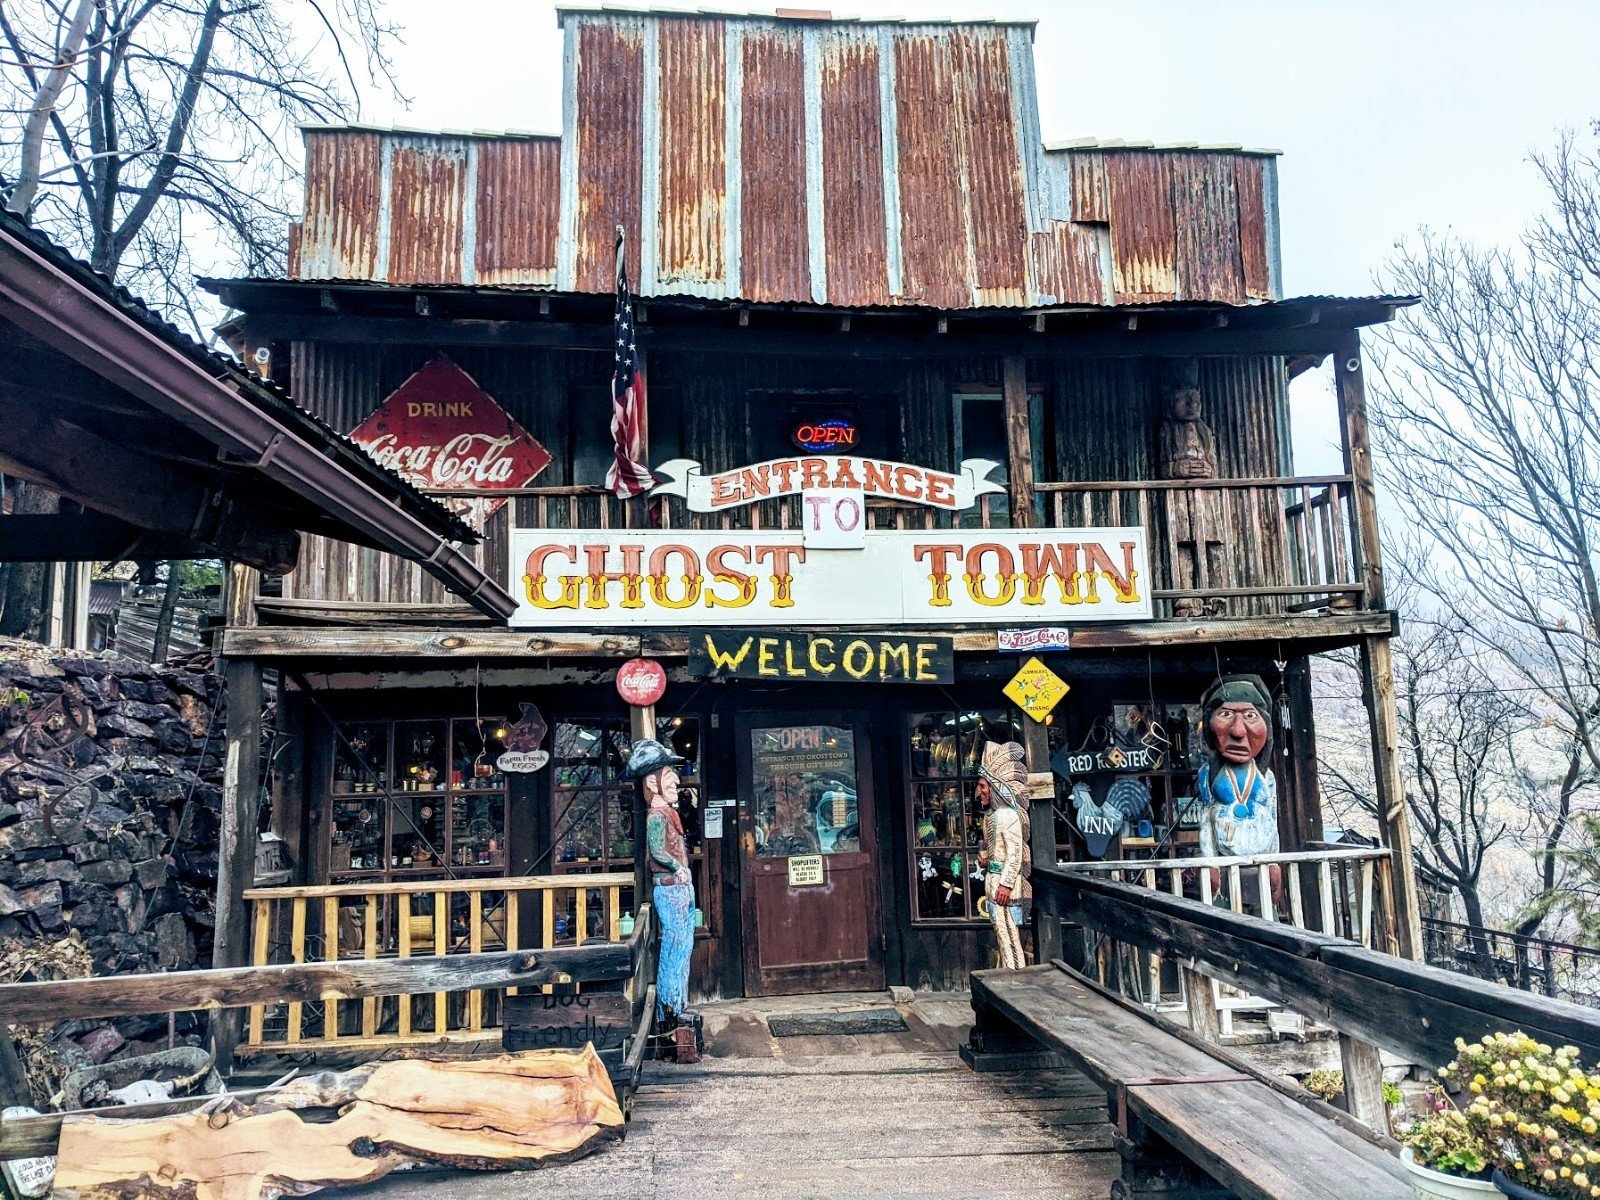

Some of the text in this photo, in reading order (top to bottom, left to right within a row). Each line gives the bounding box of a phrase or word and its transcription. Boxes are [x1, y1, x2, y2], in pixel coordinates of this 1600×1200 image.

[407, 402, 473, 417] DRINK
[798, 426, 855, 444] OPEN
[710, 458, 956, 507] ENTRANCE
[805, 496, 860, 532] TO
[521, 541, 1141, 609] GHOST TOWN
[704, 633, 938, 683] WELCOME
[780, 728, 820, 749] OPEN
[499, 754, 546, 765] Farm Fresh
[1068, 754, 1093, 773] RED
[1084, 815, 1115, 835] INN
